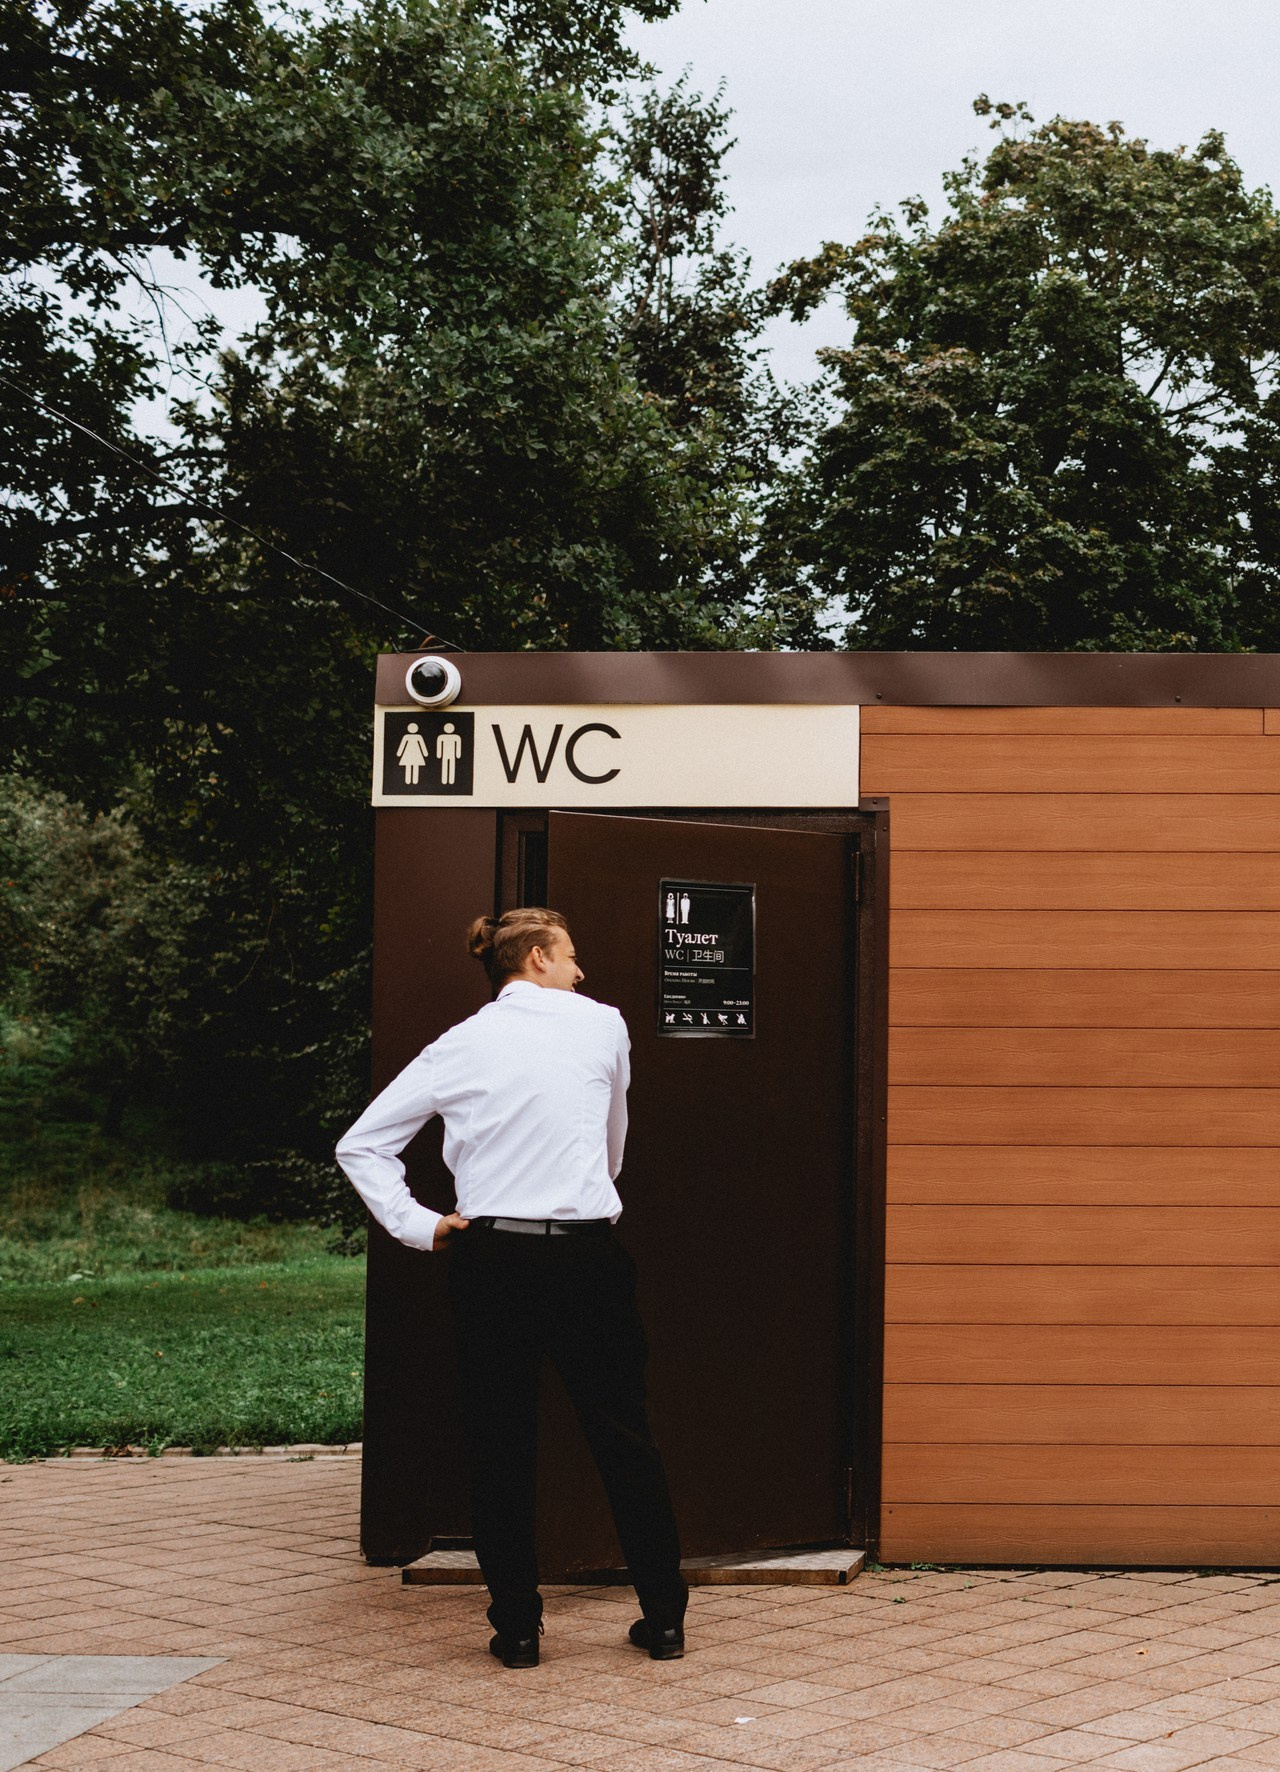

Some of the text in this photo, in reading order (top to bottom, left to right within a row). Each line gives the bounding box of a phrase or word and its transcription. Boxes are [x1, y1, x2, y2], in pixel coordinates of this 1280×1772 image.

[491, 722, 622, 784] WC
[665, 928, 718, 948] Туалет
[665, 949, 725, 963] WC 卫生间
